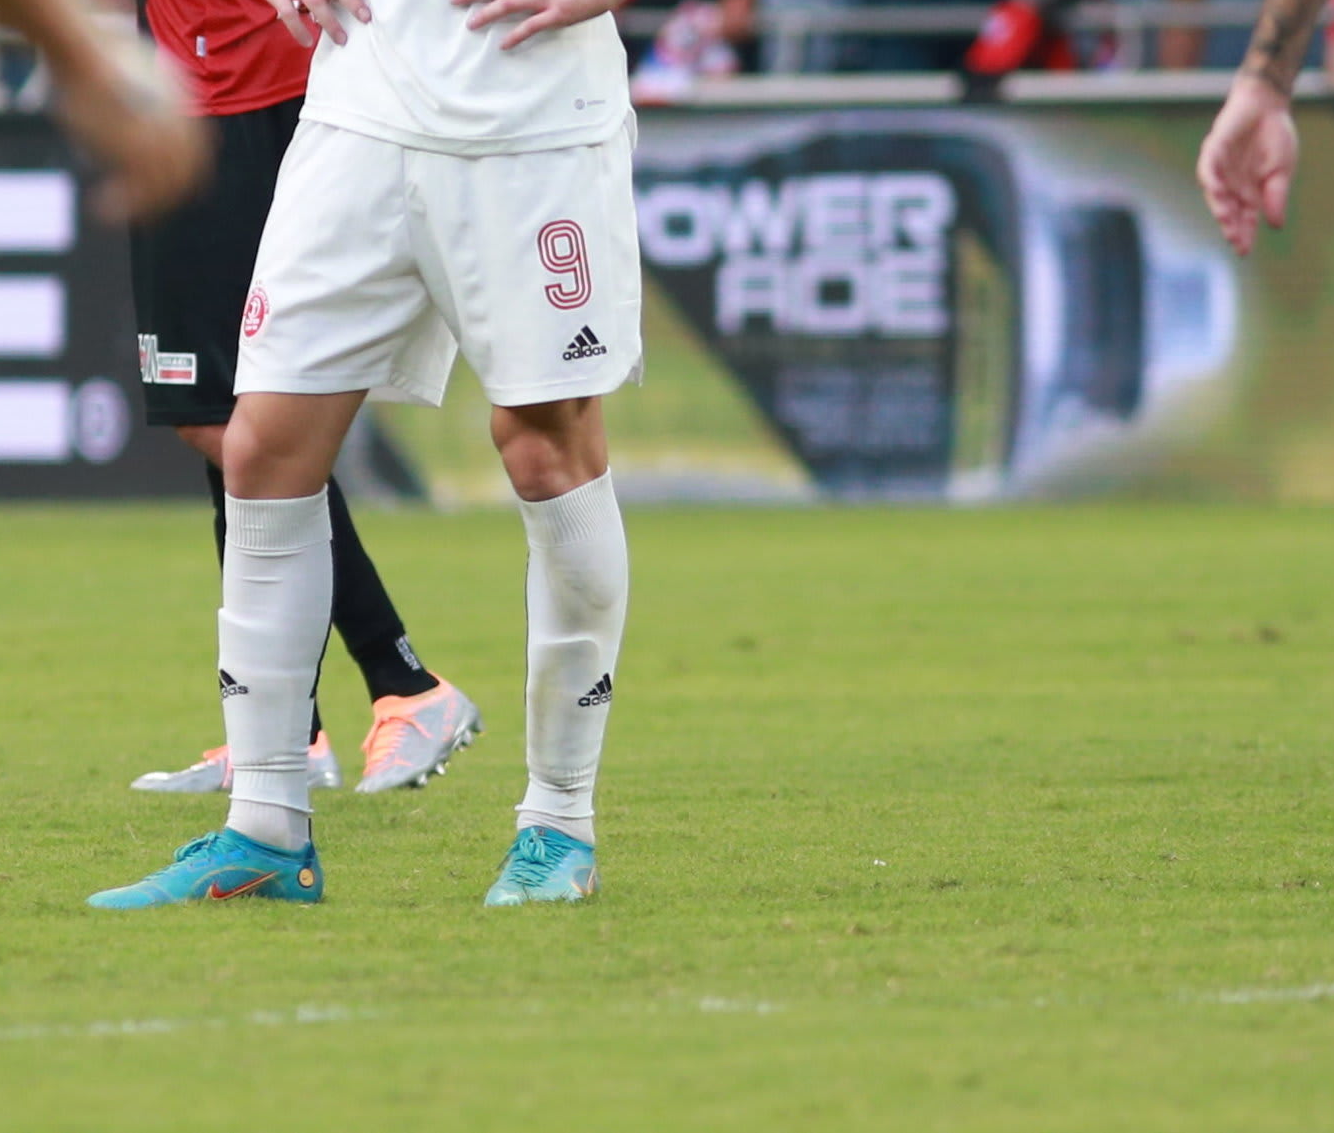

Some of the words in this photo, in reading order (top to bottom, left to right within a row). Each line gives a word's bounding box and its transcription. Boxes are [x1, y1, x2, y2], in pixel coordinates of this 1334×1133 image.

[537, 219, 592, 310] 9
[635, 172, 957, 267] OWER
[562, 342, 607, 361] adidas
